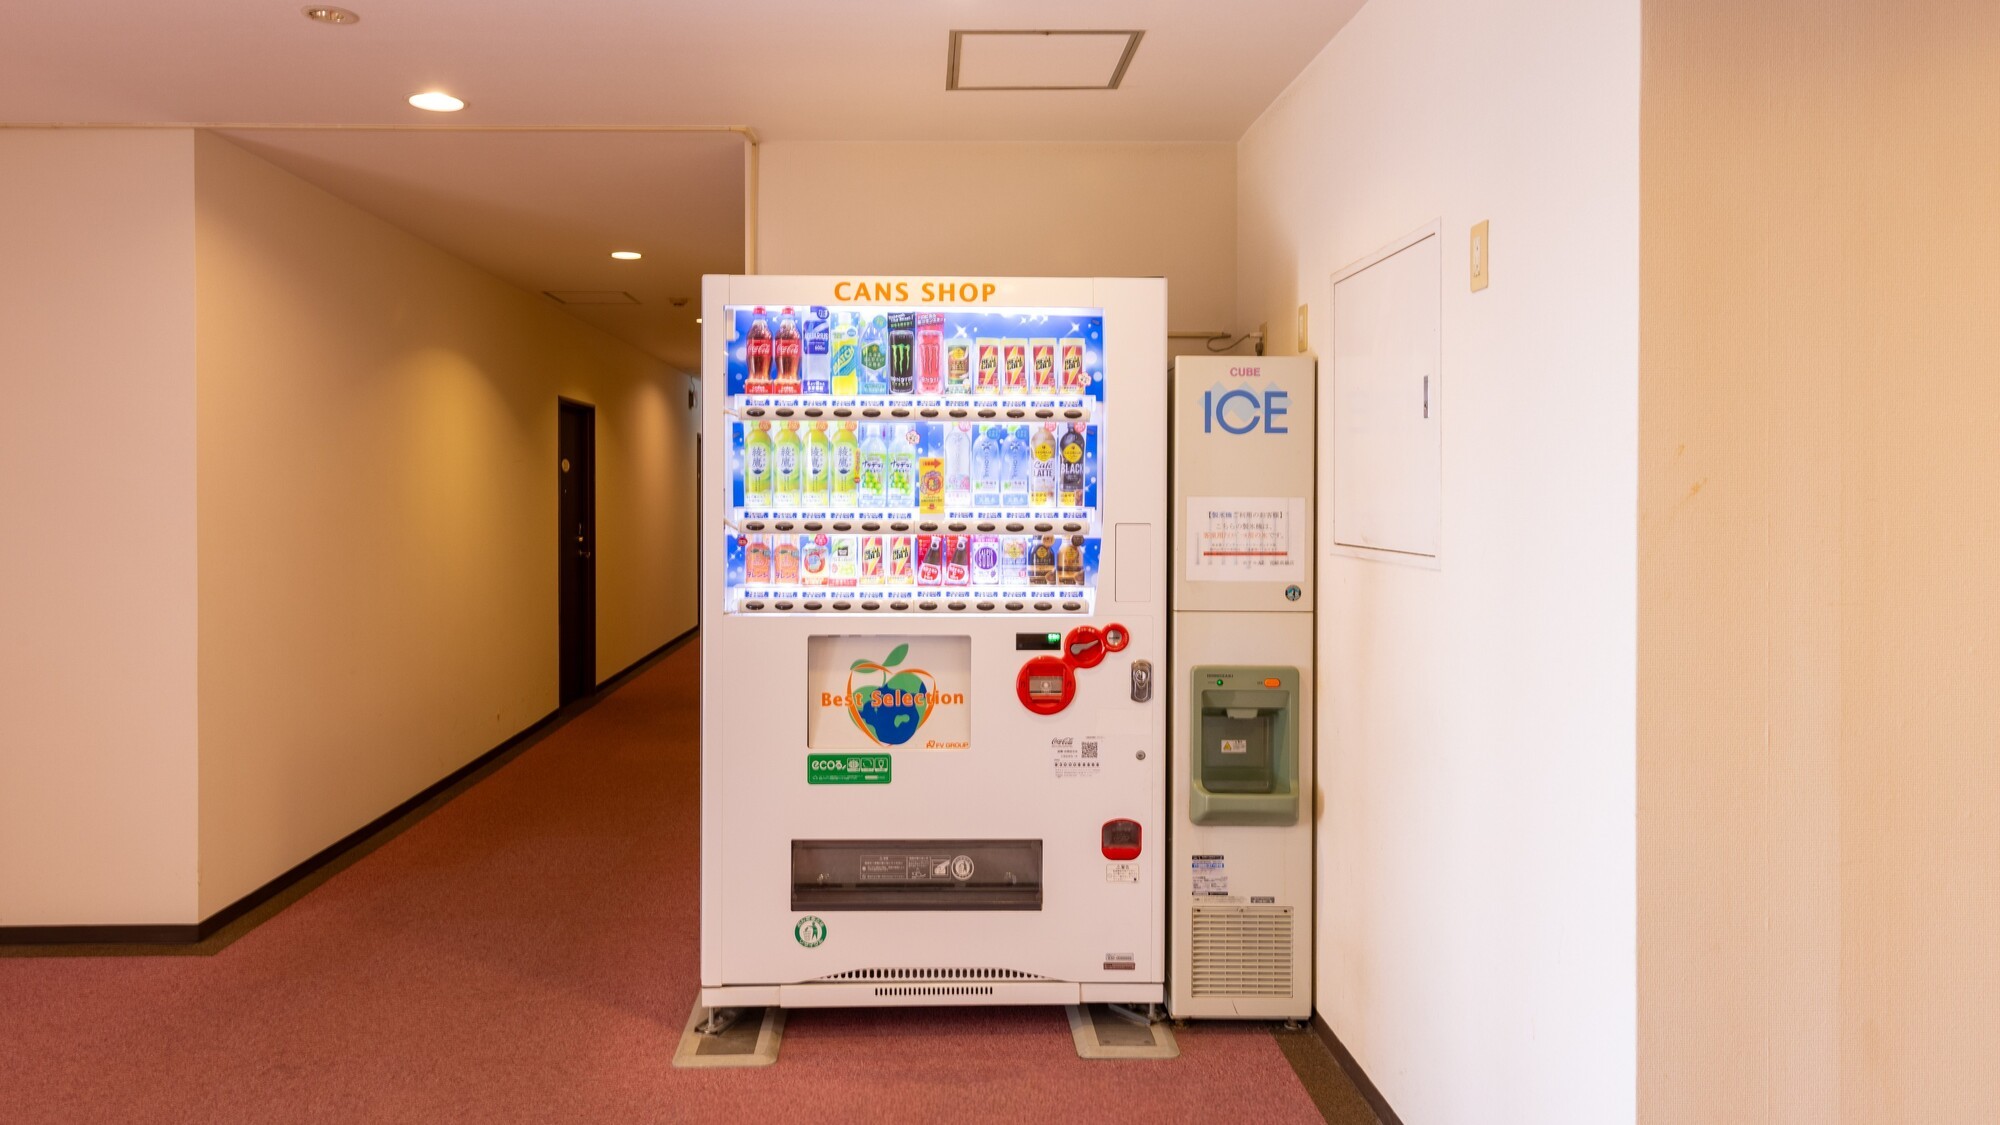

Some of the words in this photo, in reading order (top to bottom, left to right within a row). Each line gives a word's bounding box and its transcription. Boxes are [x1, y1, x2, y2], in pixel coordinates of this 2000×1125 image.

[834, 281, 909, 302] CANS
[921, 282, 996, 302] SHOP
[1230, 367, 1261, 377] CUBE
[1204, 389, 1288, 435] ICE
[1061, 463, 1084, 475] BLACK
[821, 692, 863, 707] Best
[871, 689, 964, 707] Selection
